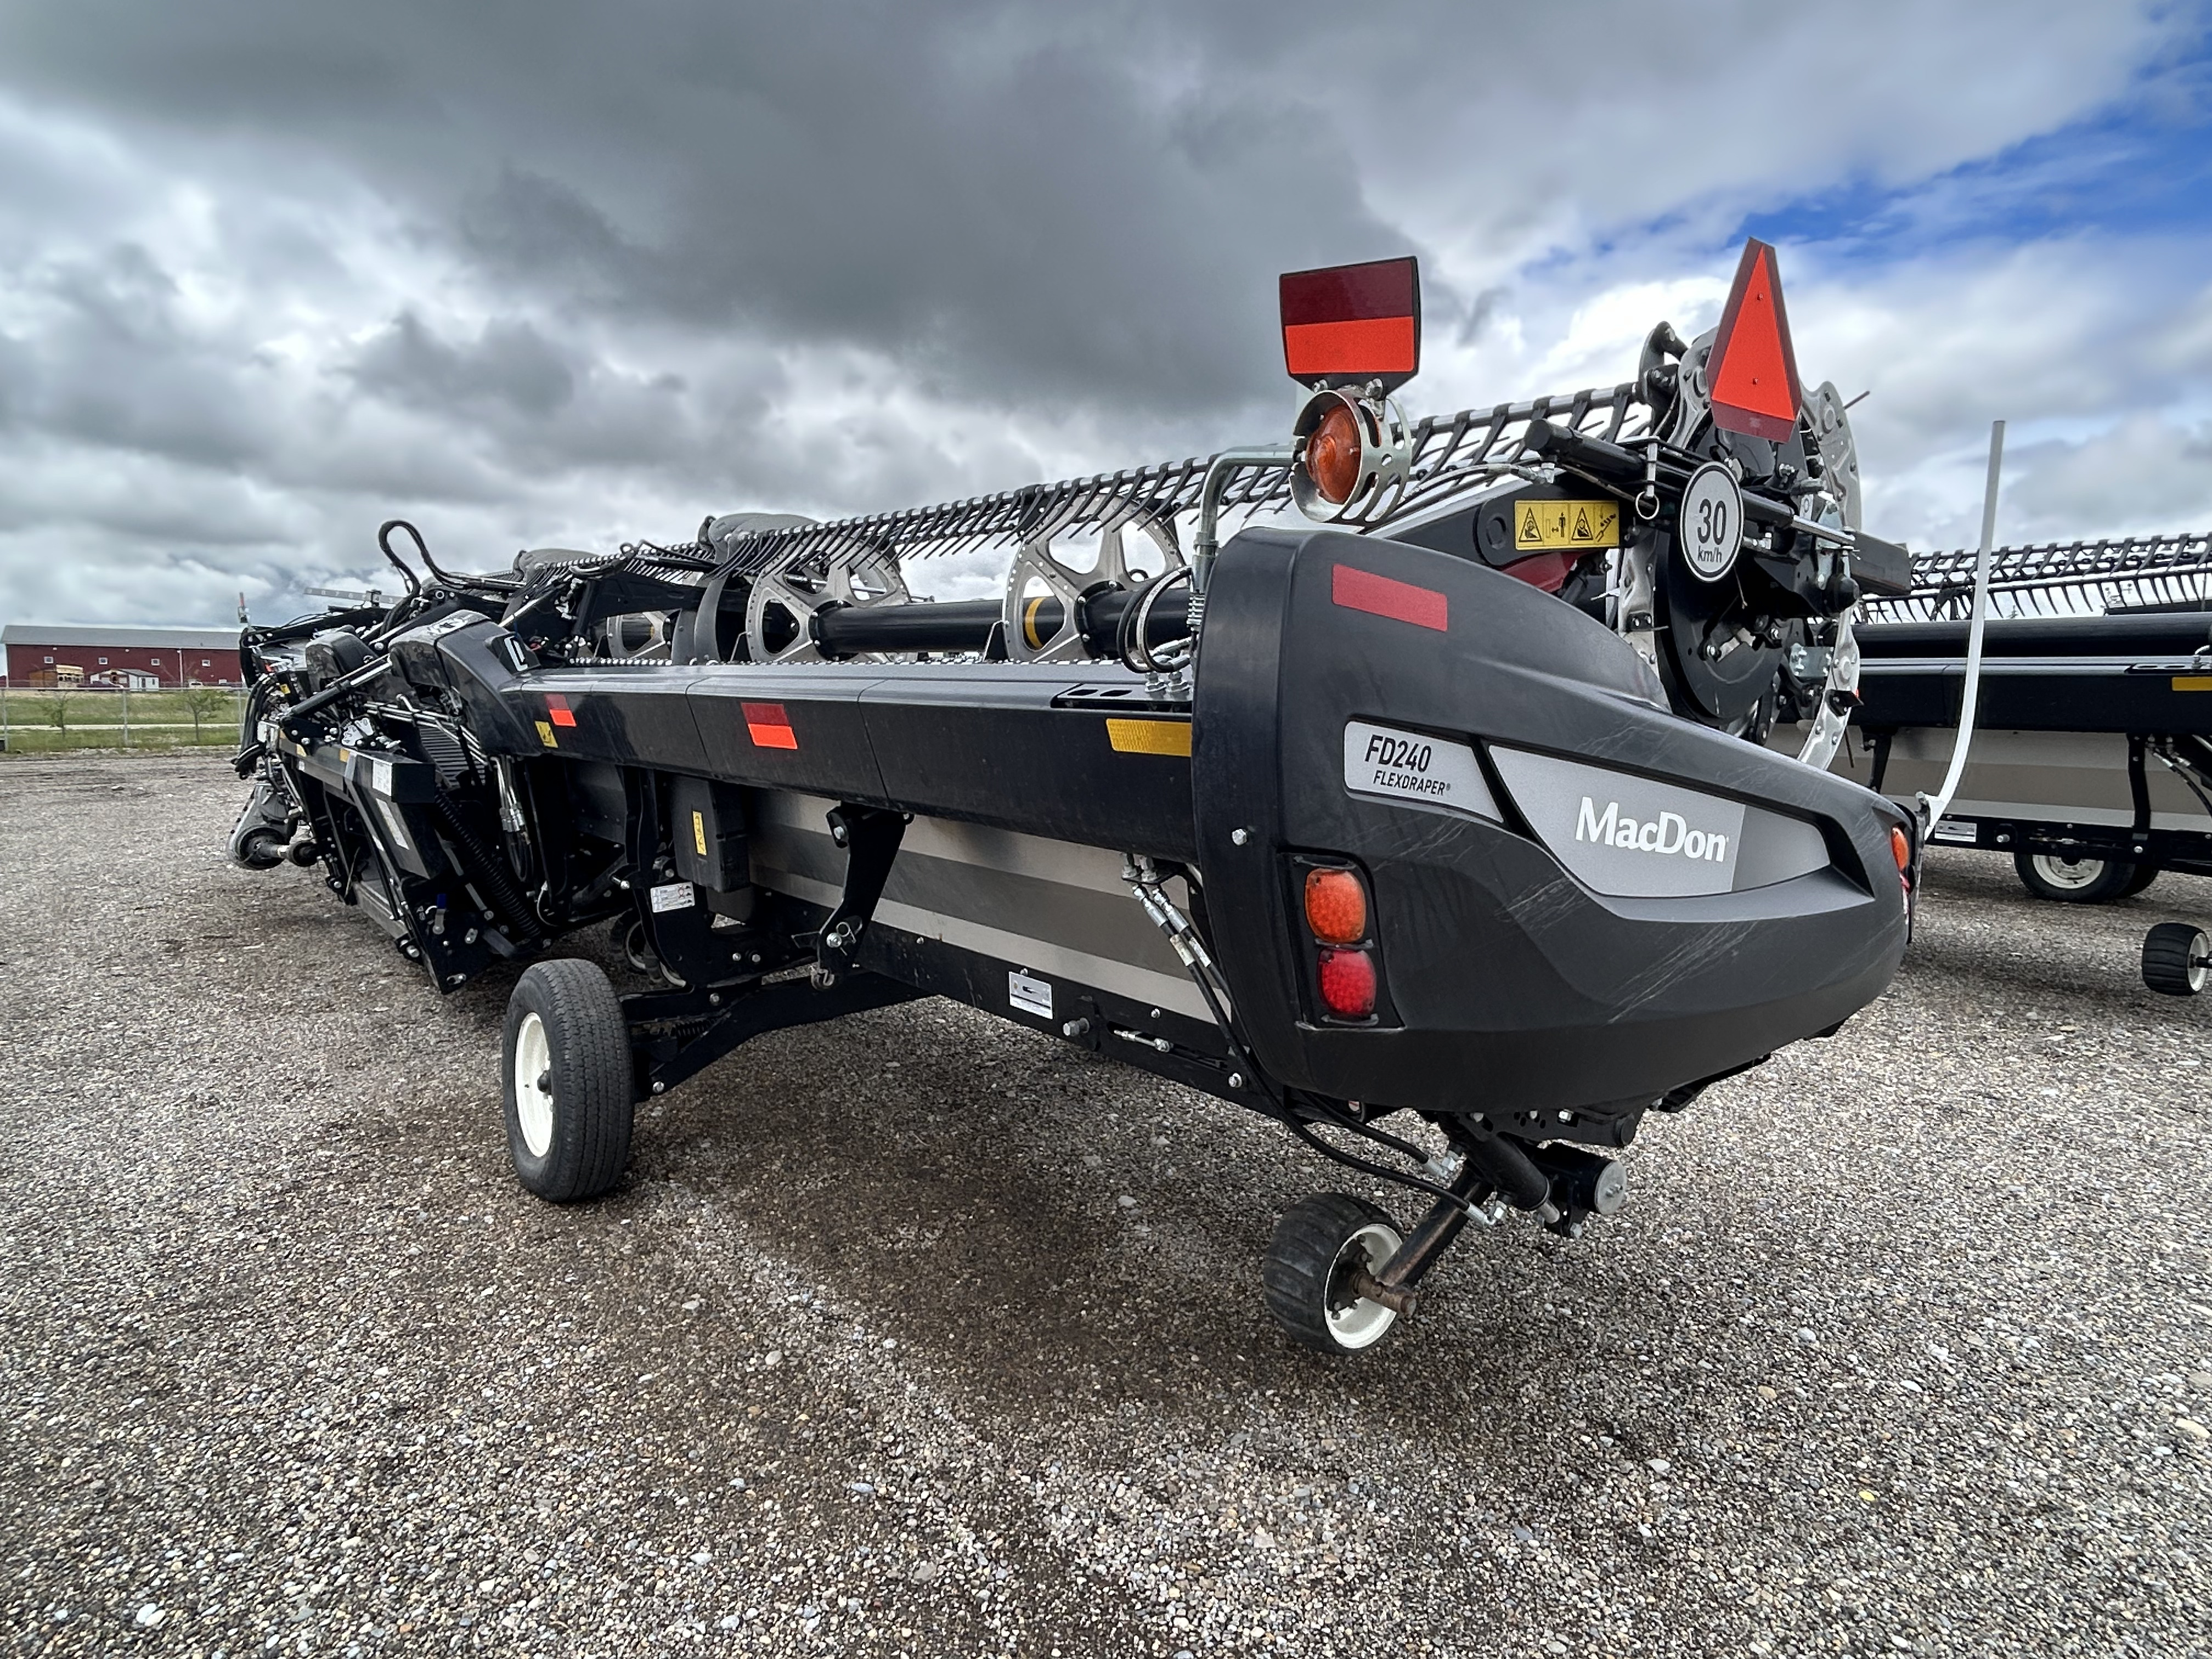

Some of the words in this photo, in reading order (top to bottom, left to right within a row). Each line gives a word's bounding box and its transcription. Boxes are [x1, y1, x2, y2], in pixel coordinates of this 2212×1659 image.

[1697, 498, 1726, 545] 30
[1697, 545, 1722, 563] km/h
[1364, 734, 1432, 772] FD240
[1576, 797, 1726, 862] MacDon
